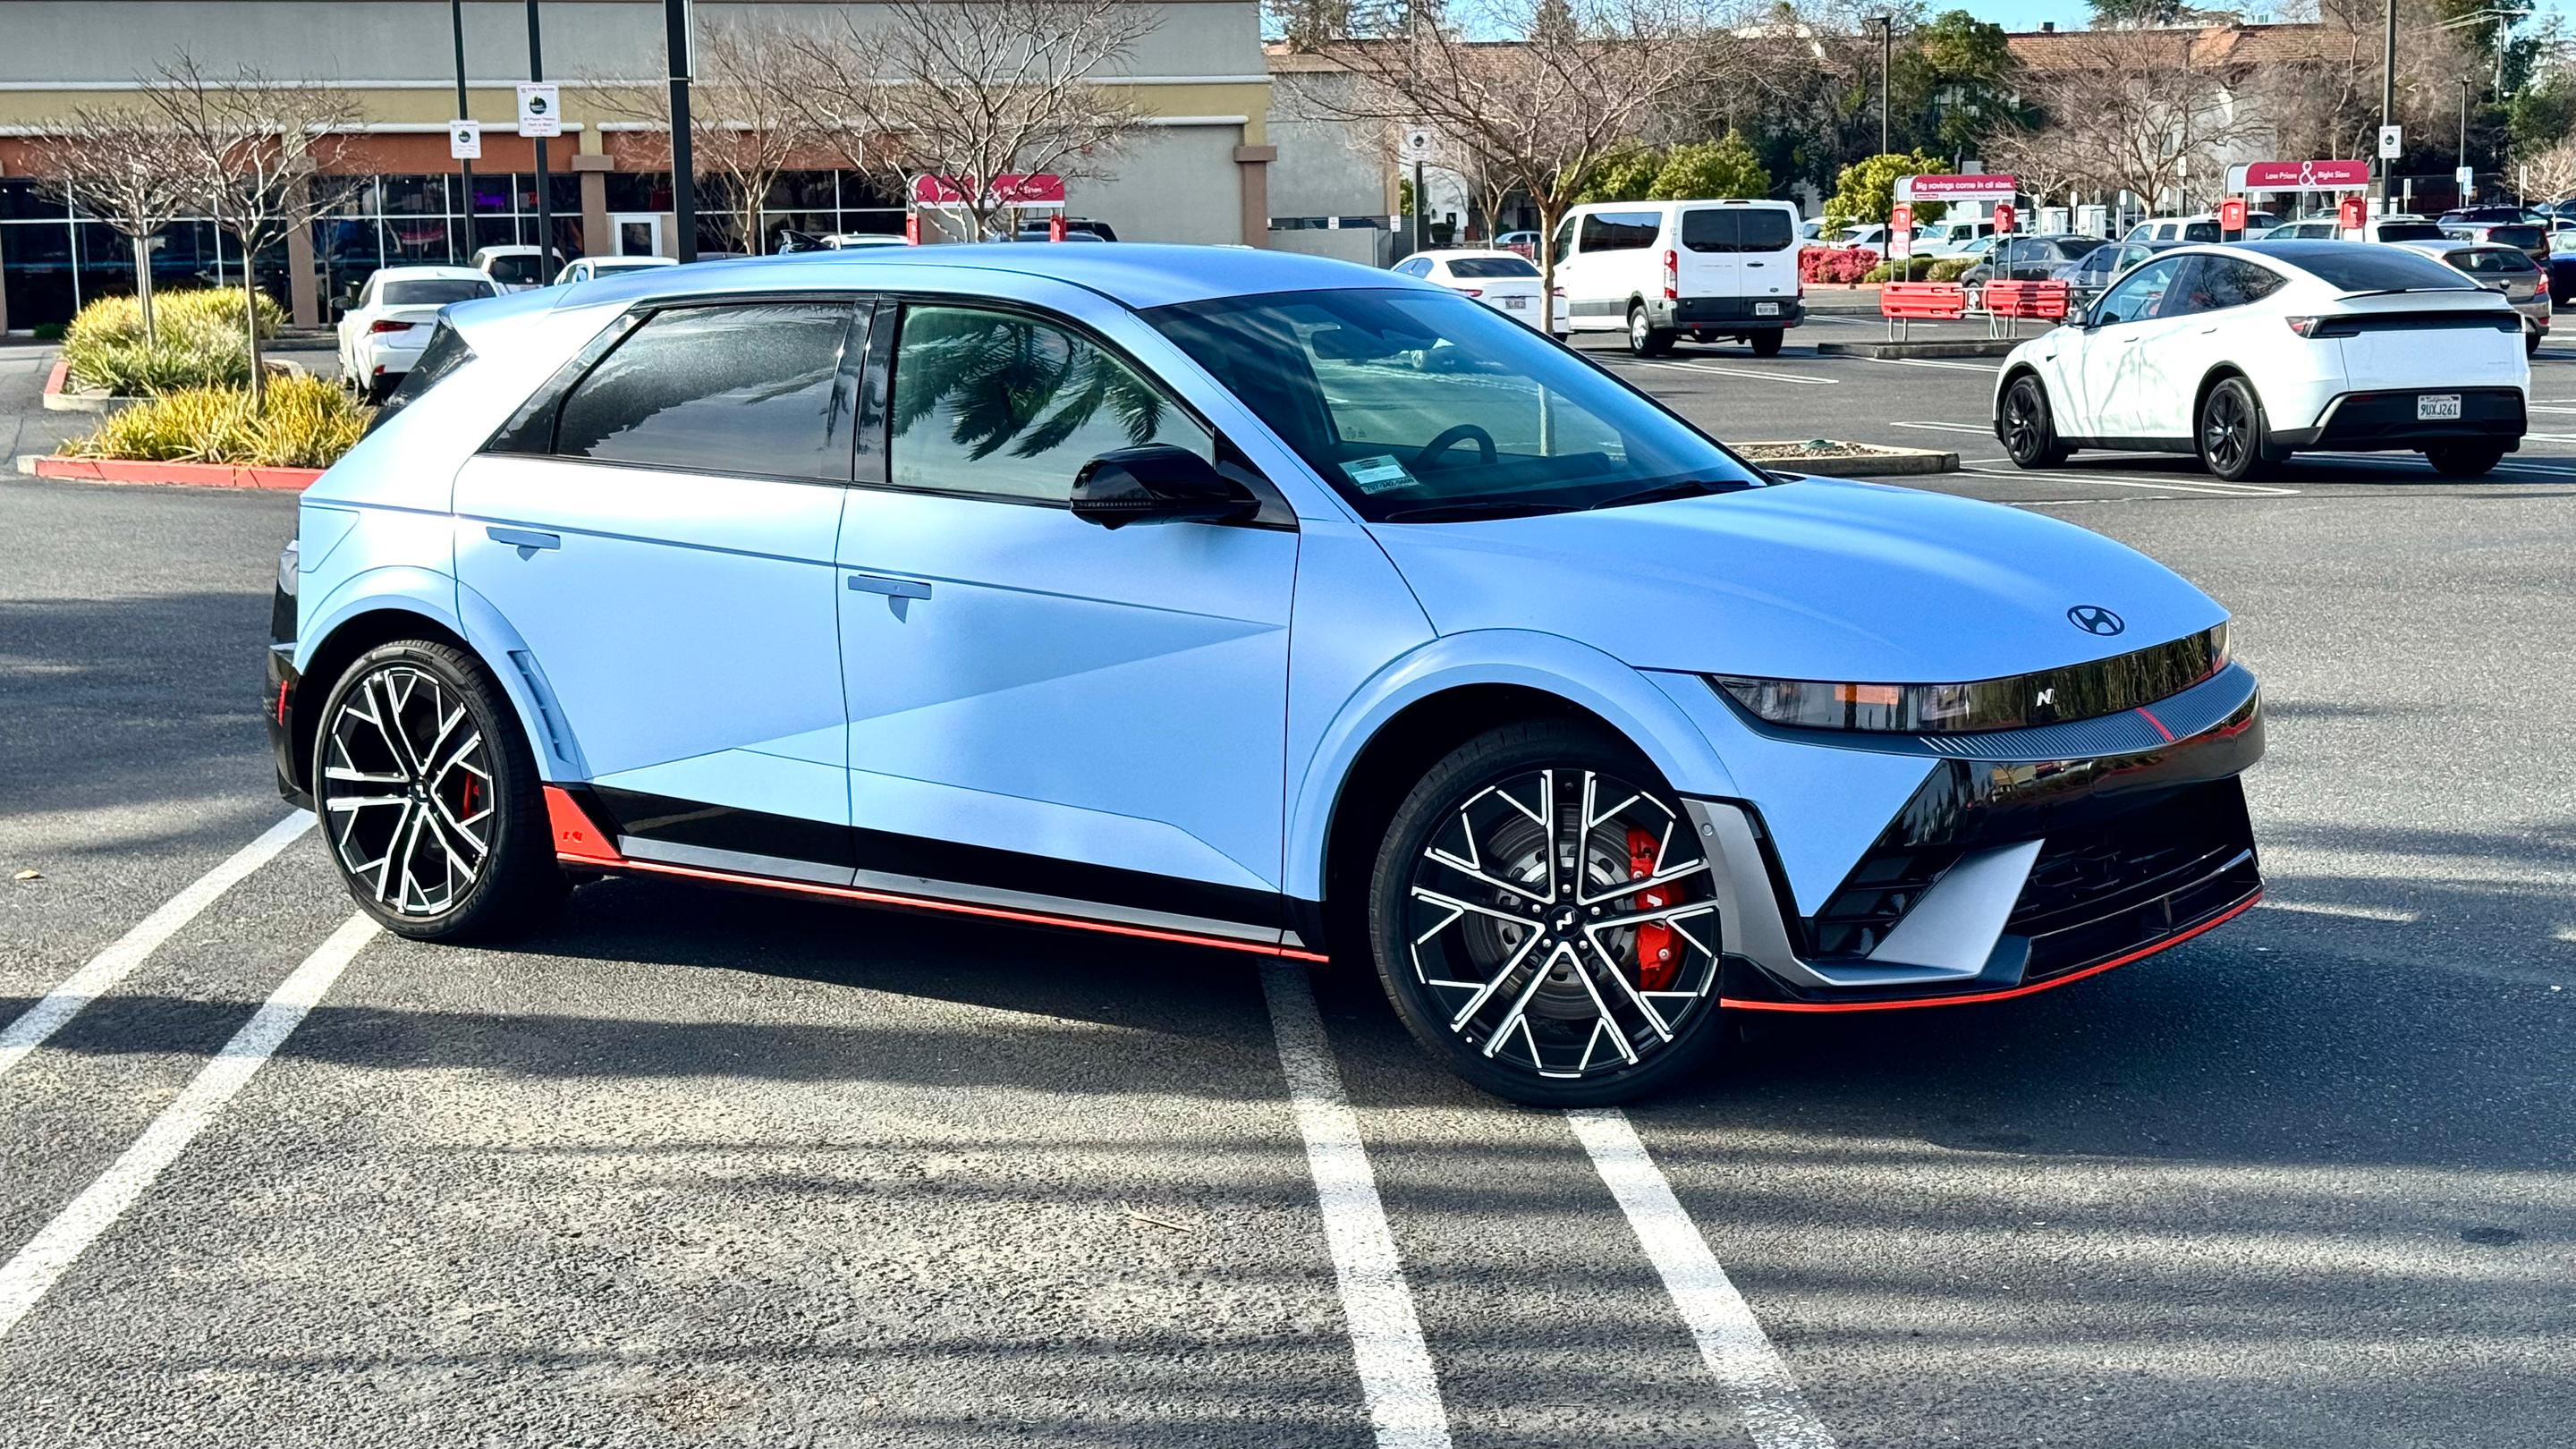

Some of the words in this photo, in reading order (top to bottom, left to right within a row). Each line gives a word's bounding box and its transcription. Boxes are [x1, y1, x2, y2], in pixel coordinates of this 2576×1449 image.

[2299, 161, 2318, 186] &
[1916, 182, 1928, 191] Big
[1928, 181, 1955, 191] savings
[1955, 182, 1977, 190] come
[1977, 181, 1985, 189] in
[1984, 181, 1994, 189] all
